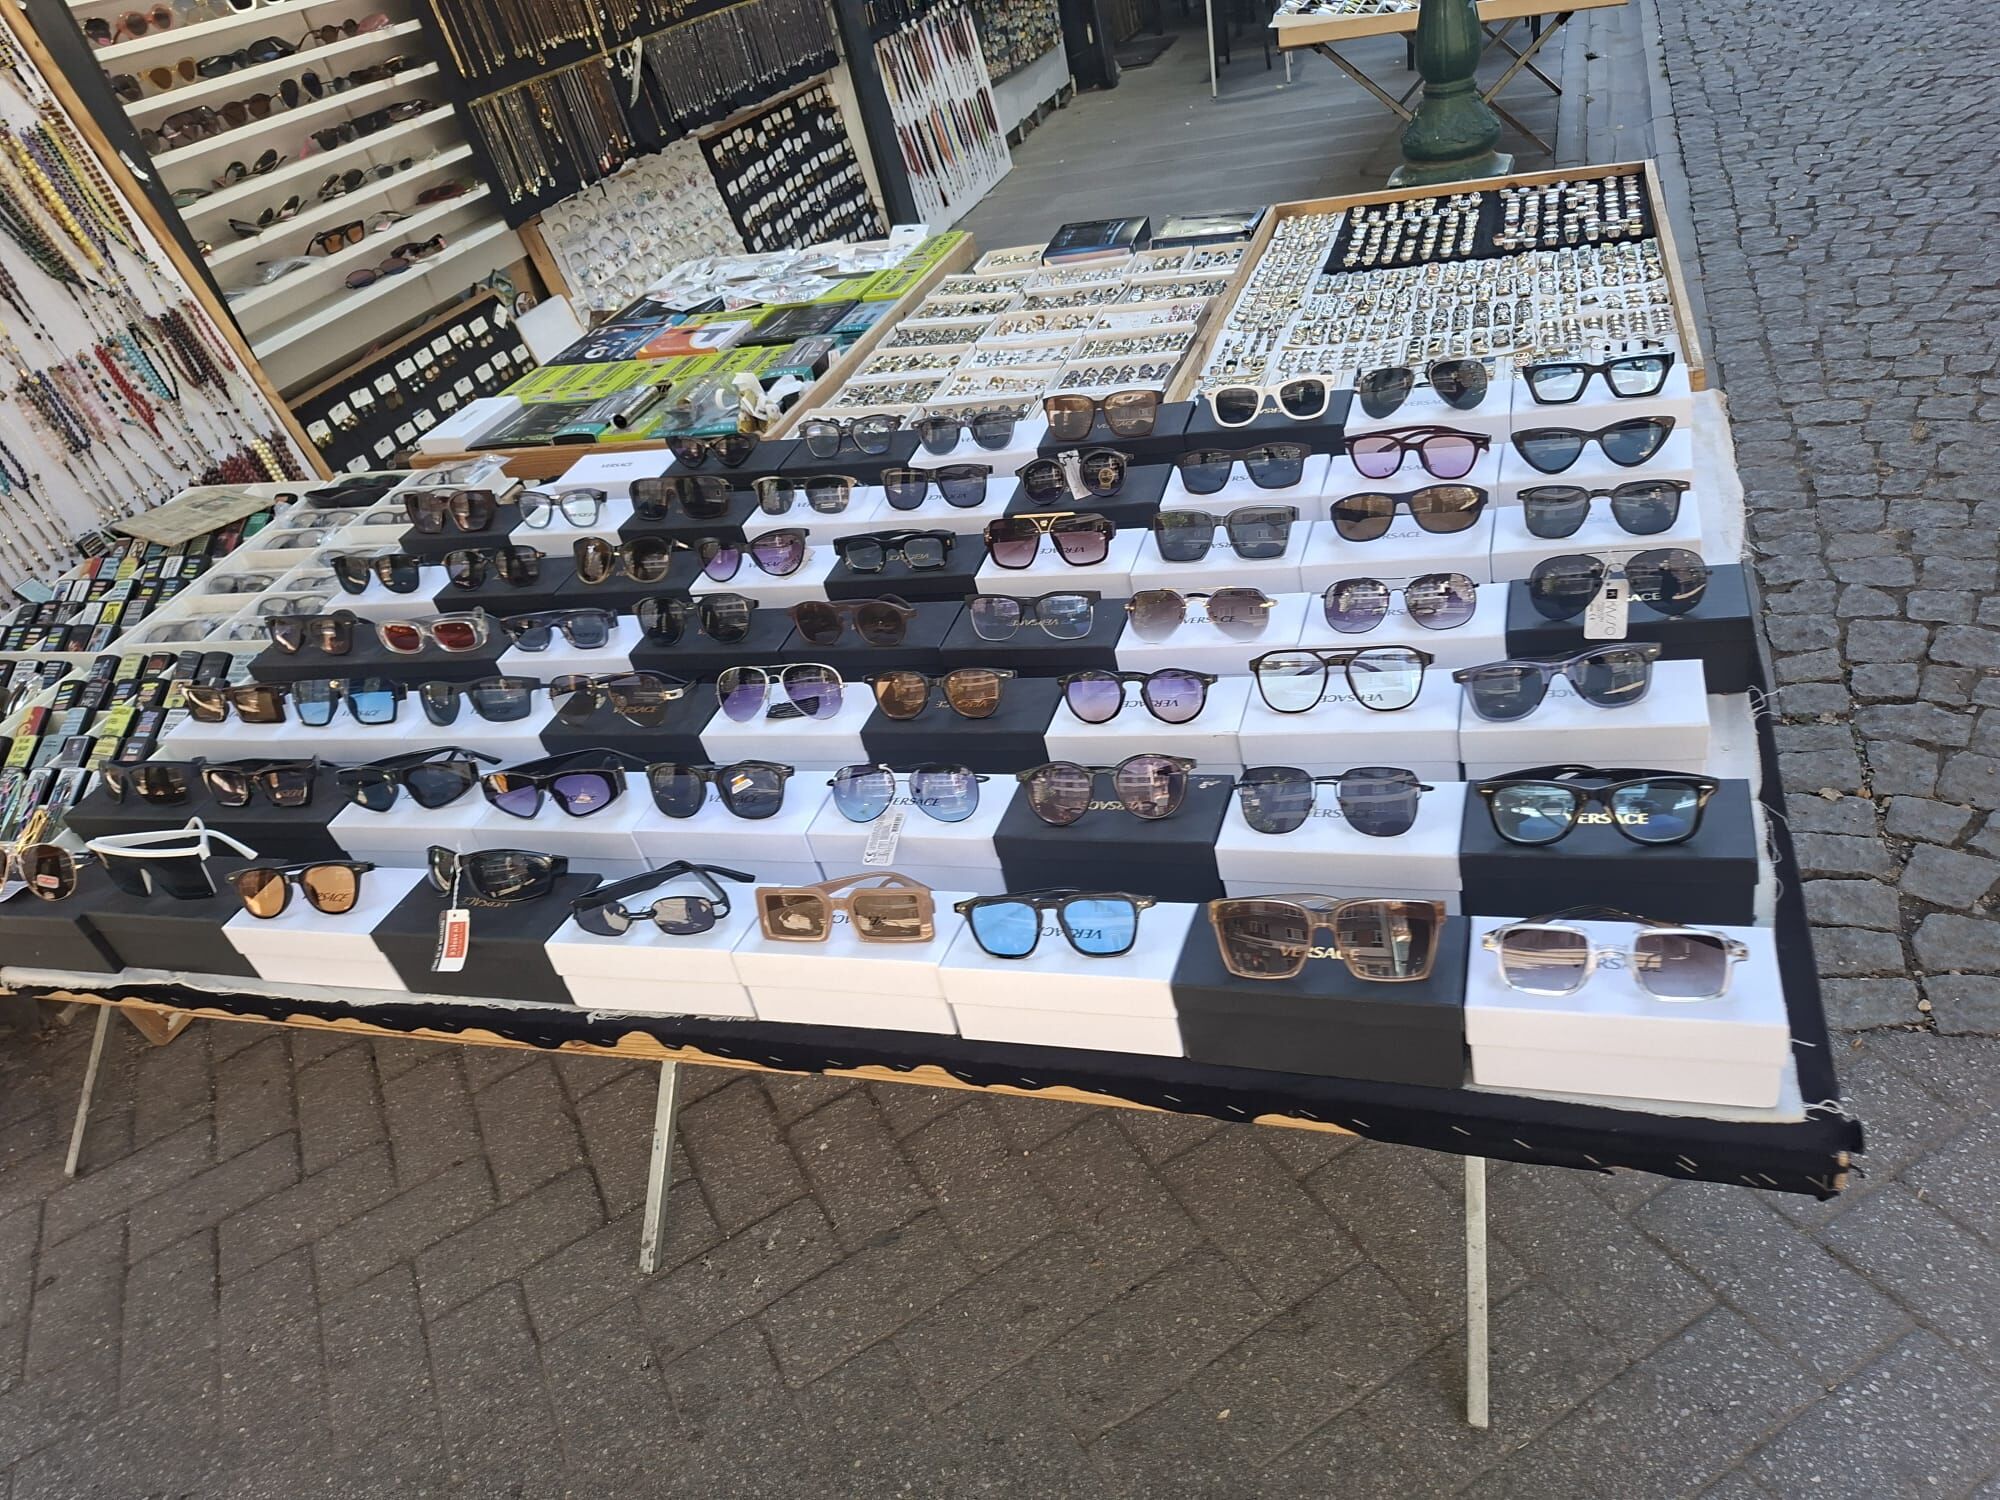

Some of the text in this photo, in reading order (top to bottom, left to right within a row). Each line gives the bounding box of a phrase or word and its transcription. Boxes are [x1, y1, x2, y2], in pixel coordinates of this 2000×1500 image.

[1040, 547, 1085, 555] VERACE
[1624, 592, 1662, 602] SACE
[1183, 615, 1236, 625] VERSCE
[1308, 808, 1370, 819] ERSCE
[1564, 813, 1649, 825] ERSCE
[308, 892, 350, 903] RSACE
